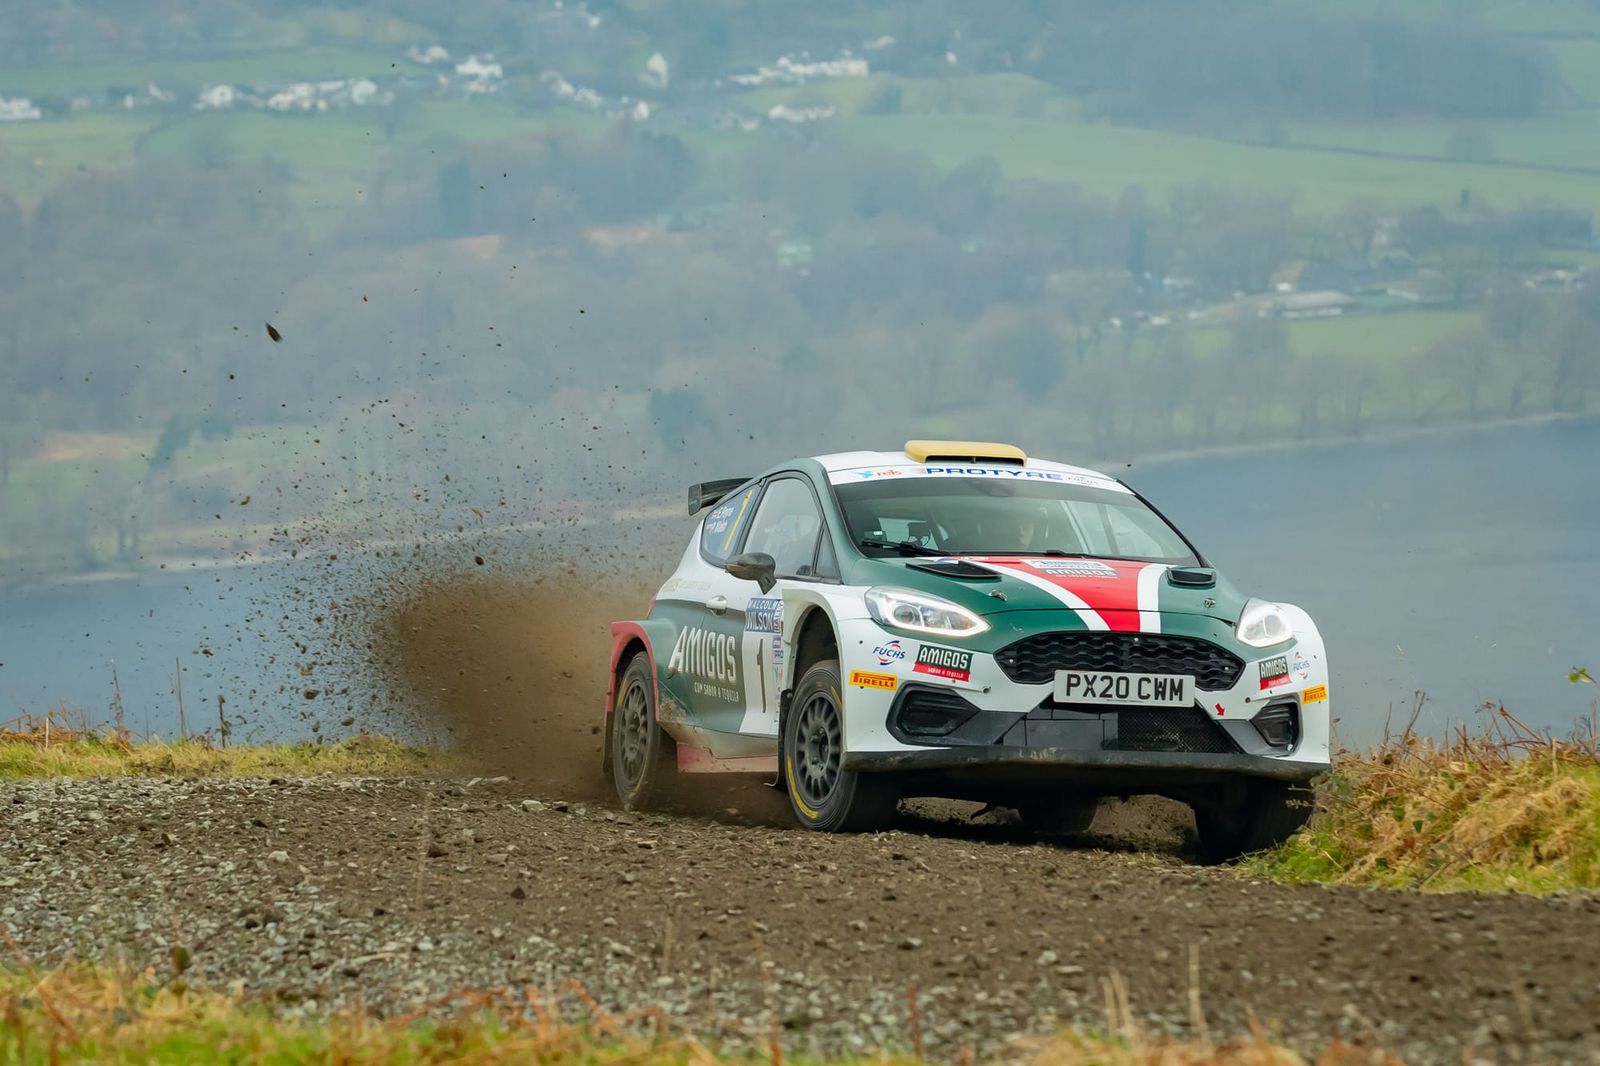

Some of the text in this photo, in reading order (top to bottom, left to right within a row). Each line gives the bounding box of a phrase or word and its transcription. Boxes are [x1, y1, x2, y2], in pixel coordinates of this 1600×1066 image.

[926, 467, 1063, 480] PROTYRE
[745, 611, 774, 631] WILSON
[668, 625, 737, 683] AMIGOS
[872, 646, 906, 660] FUCHS
[919, 646, 970, 670] AMIGOS
[756, 638, 767, 713] 1
[1260, 658, 1287, 677] AMIGOS
[853, 672, 895, 688] PIRELLI
[1066, 673, 1183, 701] PX20 CWM
[1303, 687, 1327, 702] PIRELLI
